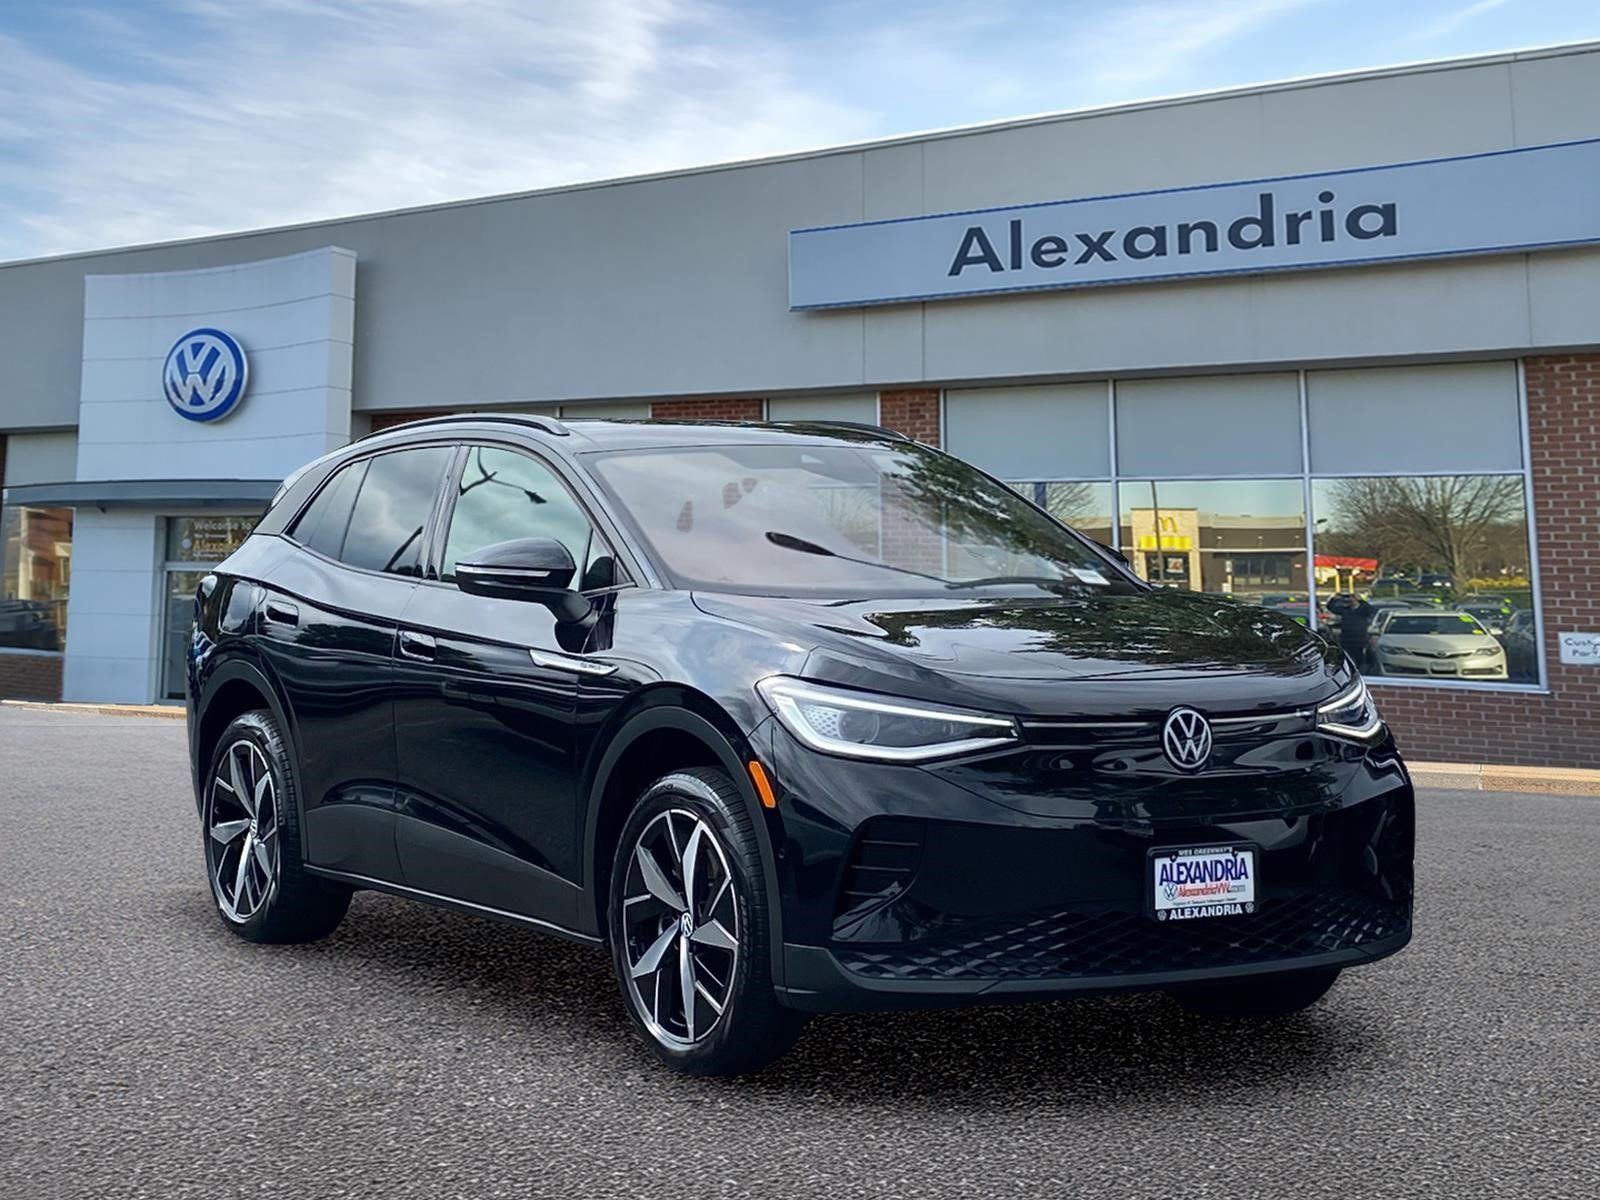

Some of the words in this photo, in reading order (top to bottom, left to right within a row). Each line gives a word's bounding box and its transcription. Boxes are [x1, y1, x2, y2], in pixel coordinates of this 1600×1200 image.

[948, 190, 1398, 276] Alexandria
[165, 332, 240, 415] VW
[1165, 710, 1210, 766] VW
[1159, 857, 1249, 886] ALEXANDRIA
[1169, 903, 1243, 920] ALEXANDRIA
